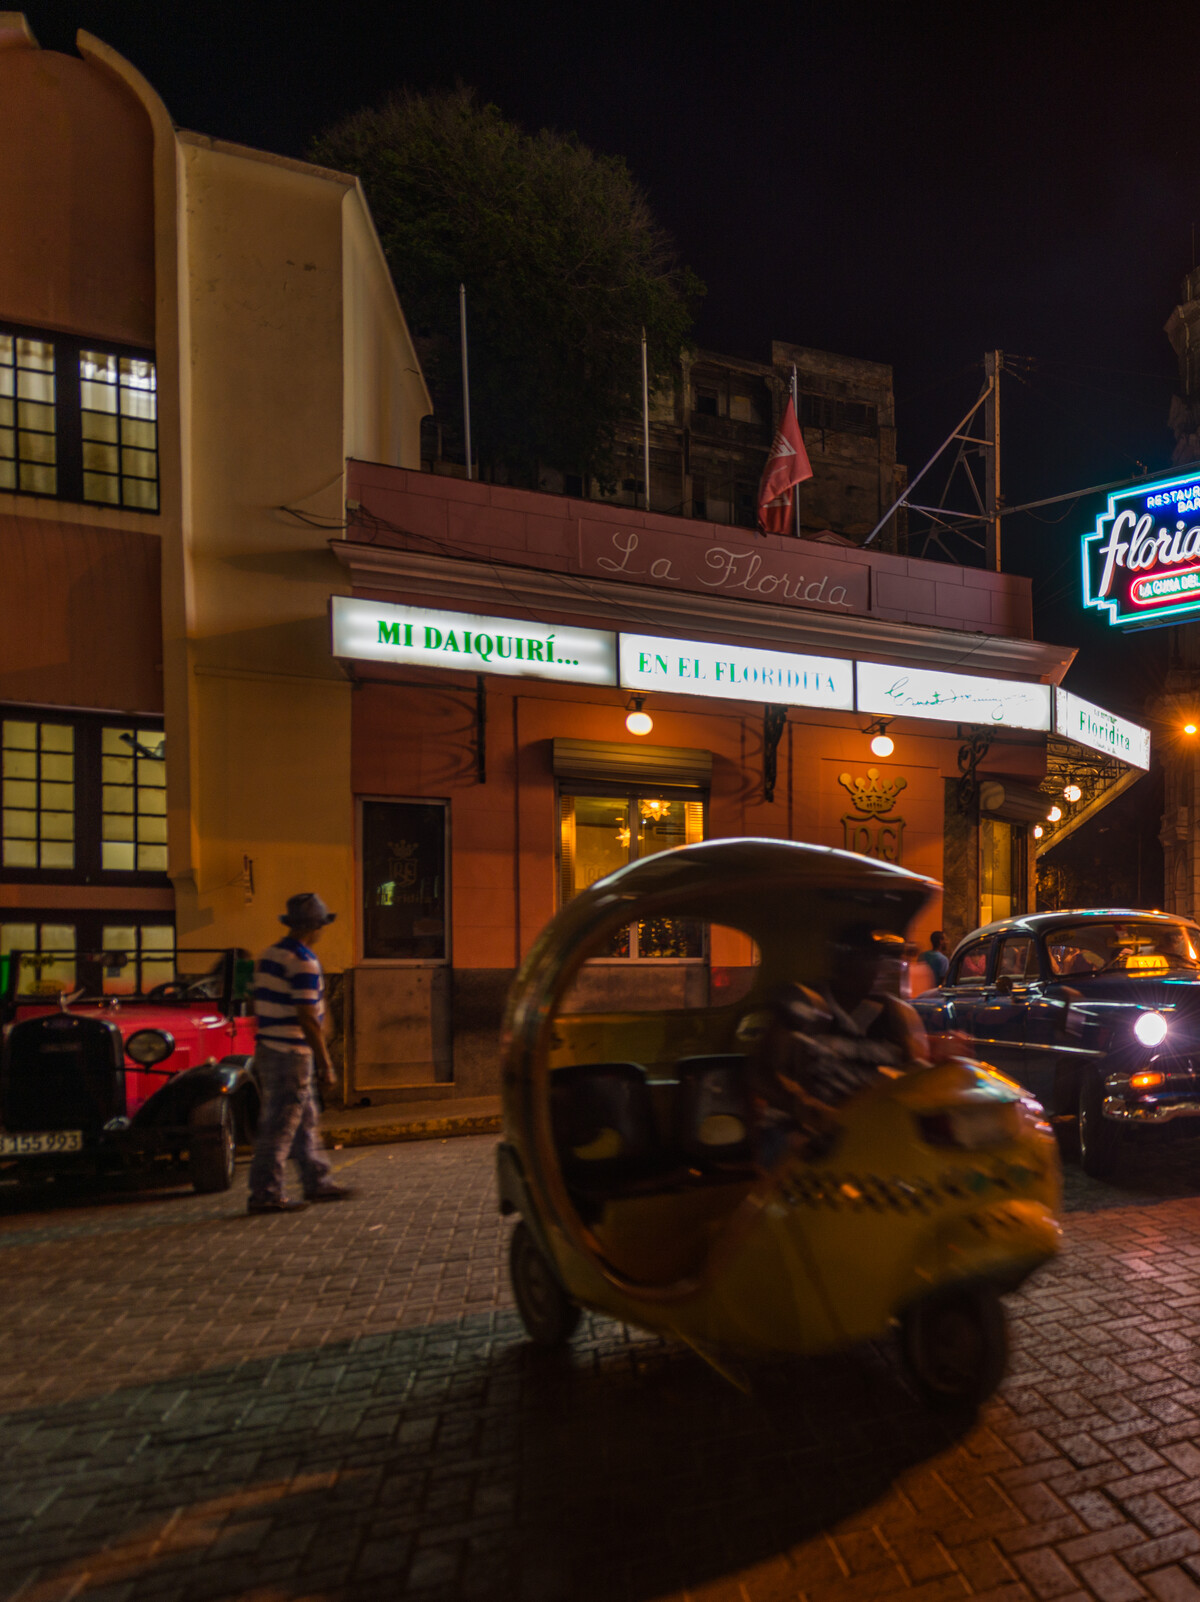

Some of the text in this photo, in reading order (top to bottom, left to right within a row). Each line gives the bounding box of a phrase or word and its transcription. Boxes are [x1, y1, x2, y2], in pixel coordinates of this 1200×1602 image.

[597, 532, 854, 607] La Florida
[1139, 583, 1153, 597] LA
[1153, 578, 1181, 594] CUNA
[1181, 573, 1200, 589] DEL
[377, 620, 580, 667] MI DAIQUIRÍ...
[637, 651, 836, 693] EN EL FLORIDITA
[1080, 711, 1130, 751] Floridita
